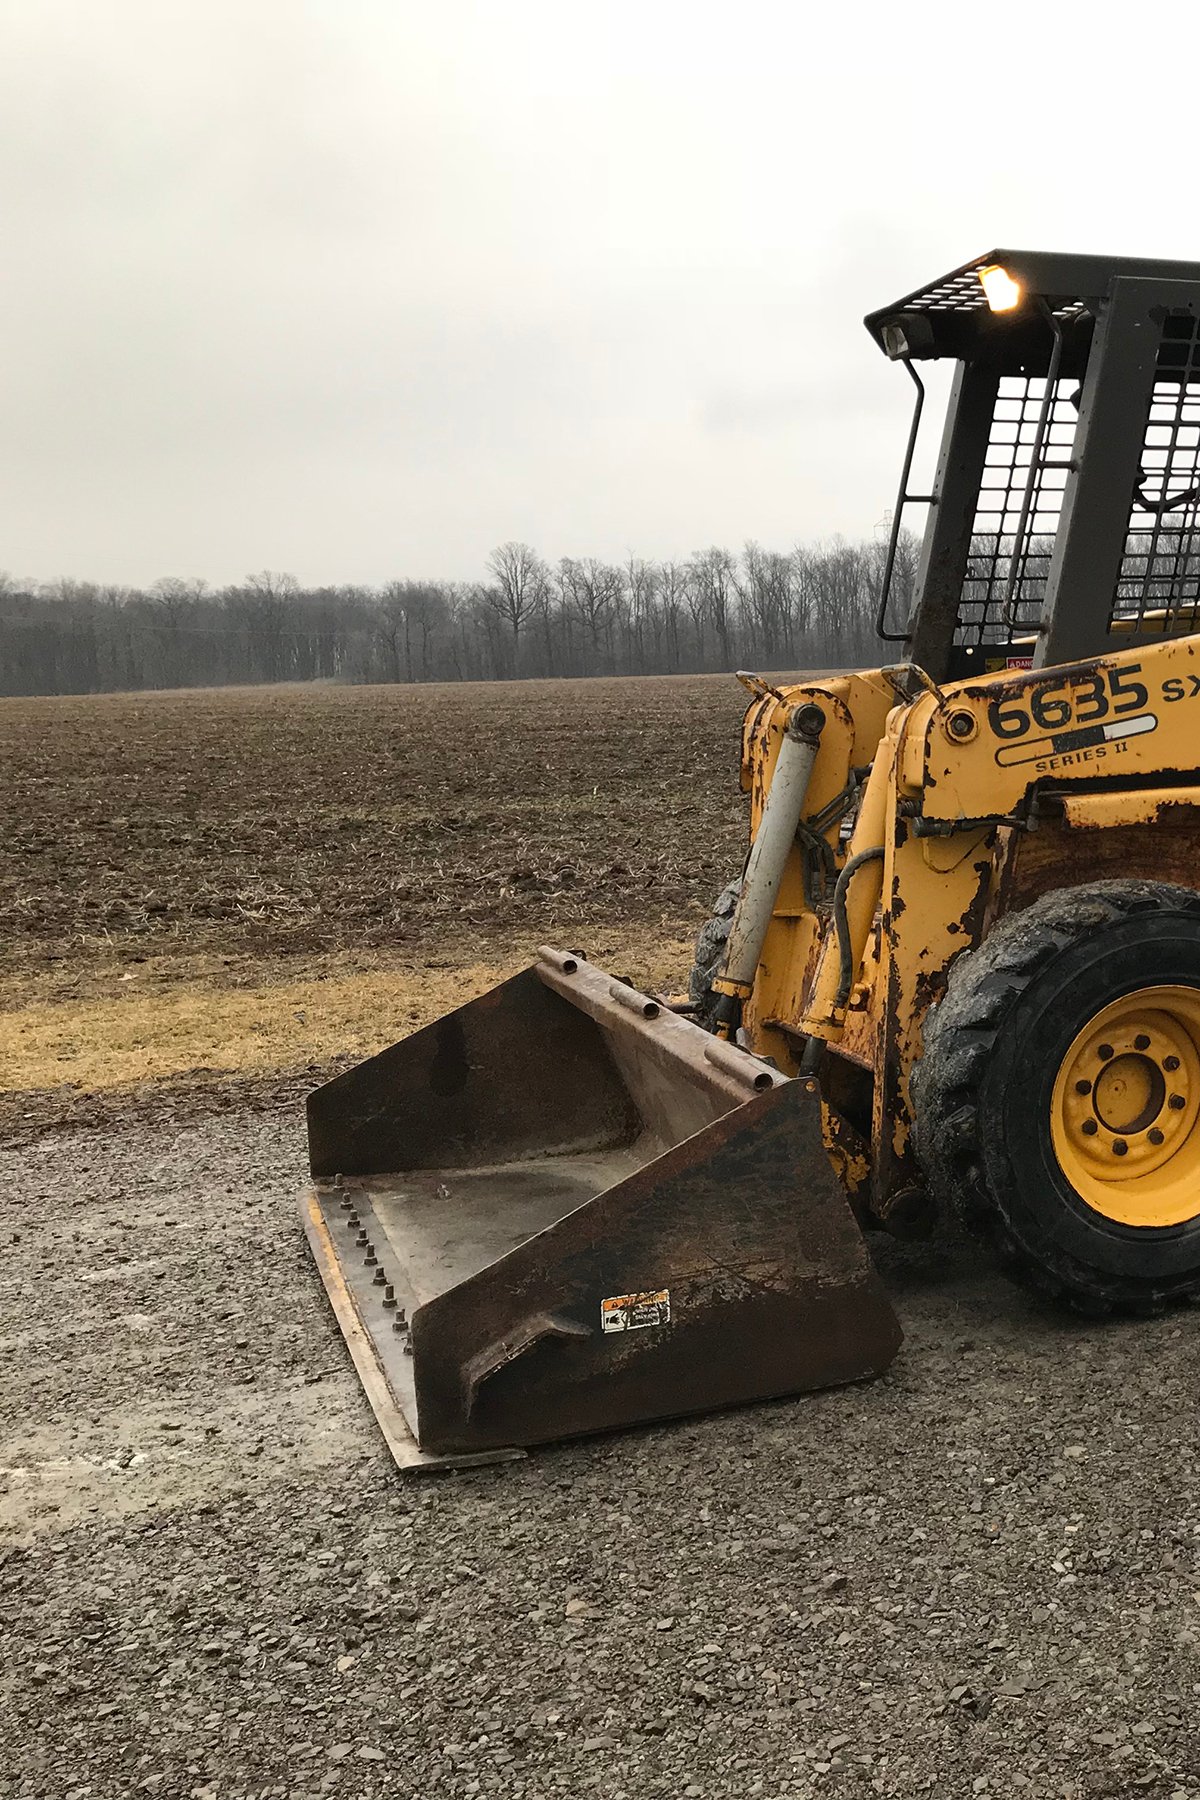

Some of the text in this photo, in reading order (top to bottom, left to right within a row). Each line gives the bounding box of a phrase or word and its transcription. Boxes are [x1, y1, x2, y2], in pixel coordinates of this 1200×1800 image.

[988, 663, 1149, 740] 6635
[1035, 741, 1128, 773] SERIES II
